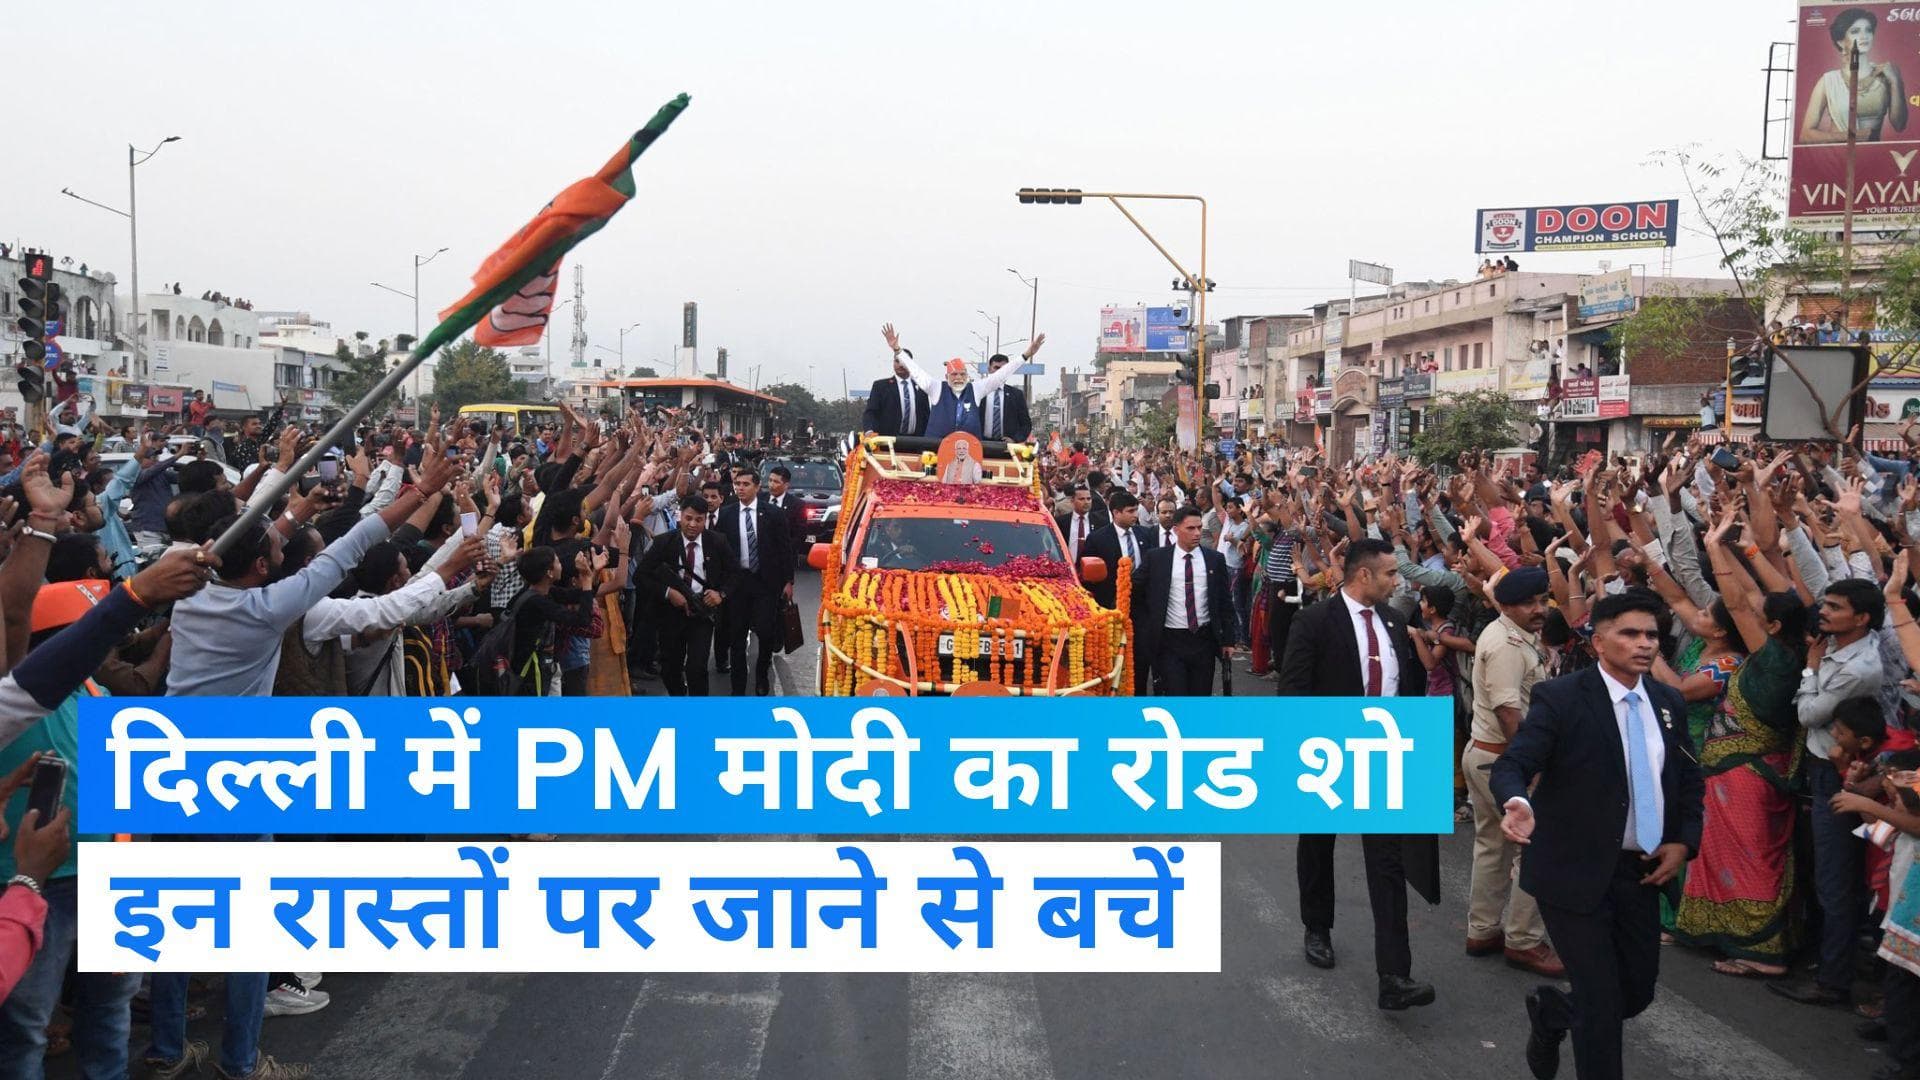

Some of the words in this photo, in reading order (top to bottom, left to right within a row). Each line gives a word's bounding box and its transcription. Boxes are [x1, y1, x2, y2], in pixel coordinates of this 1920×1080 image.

[1866, 206, 1887, 214] YOUR
[1535, 202, 1668, 234] DOON
[1535, 234, 1605, 244] CHAMPION
[1611, 231, 1667, 241] SCHOOL
